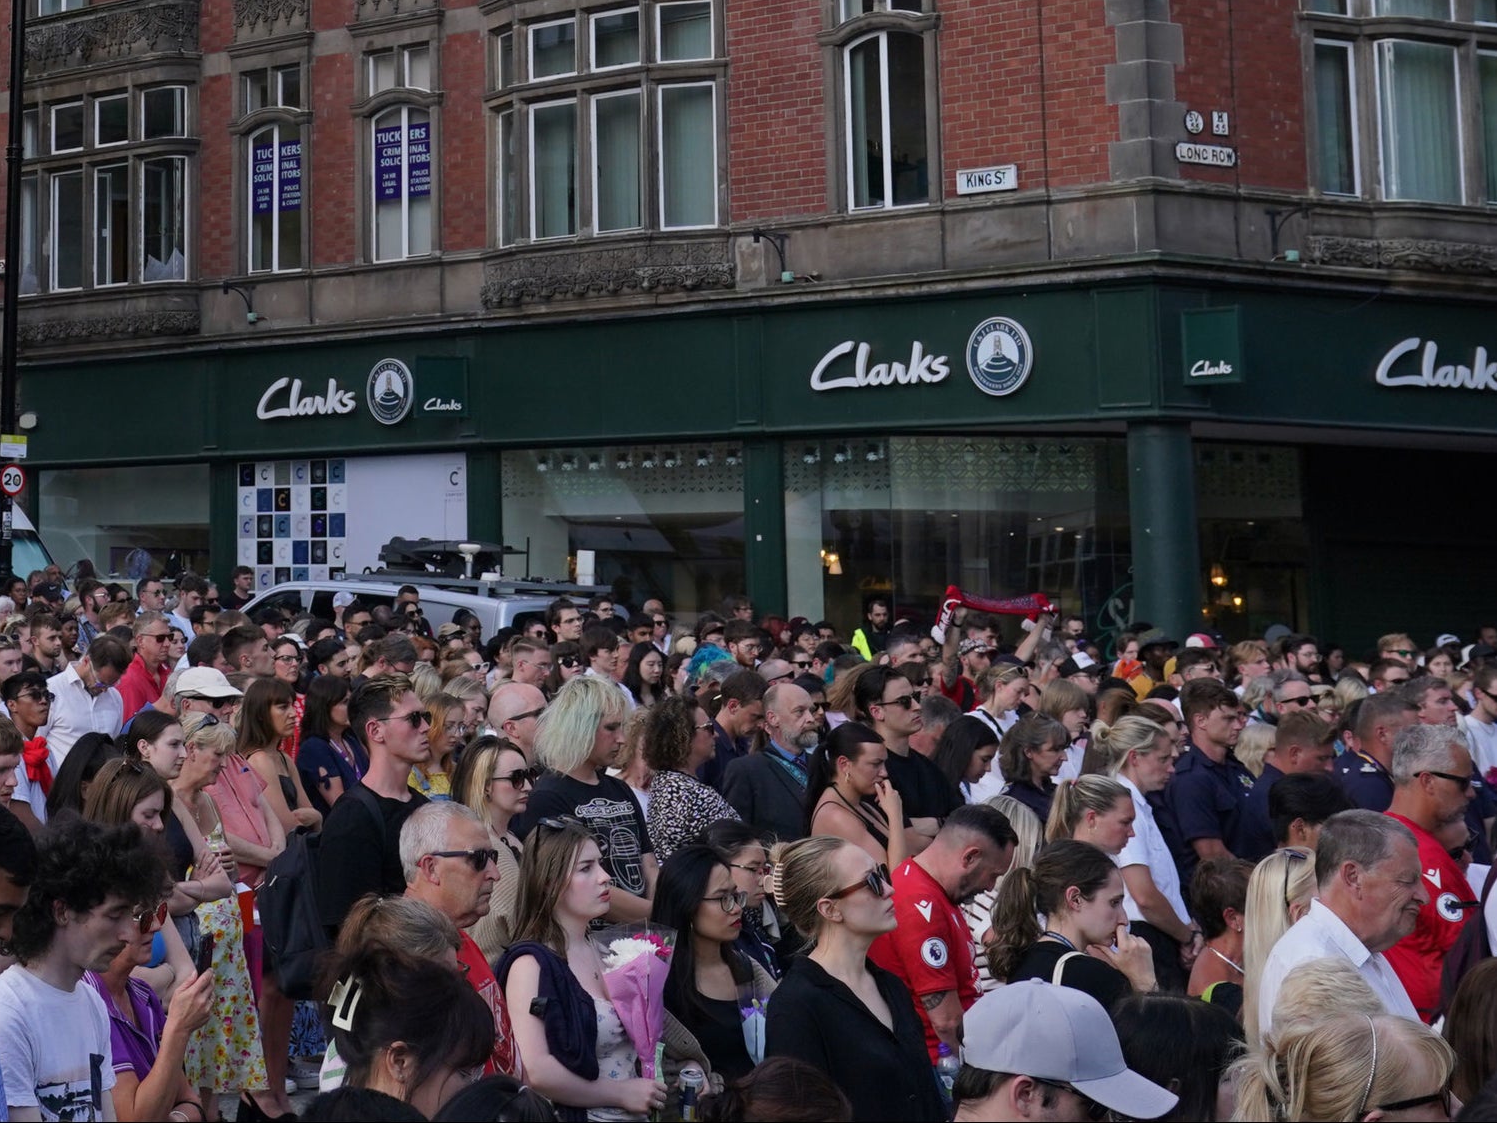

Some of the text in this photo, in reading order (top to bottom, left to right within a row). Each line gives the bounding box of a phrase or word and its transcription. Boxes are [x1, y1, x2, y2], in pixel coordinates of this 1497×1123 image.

[1211, 149, 1233, 163] ROW
[966, 173, 992, 188] KING
[810, 340, 950, 391] Clarks
[1190, 359, 1233, 376] Clarks
[257, 377, 357, 420] Clarks
[423, 397, 463, 411] Clarks
[4, 473, 22, 487] 20
[449, 471, 459, 486] C
